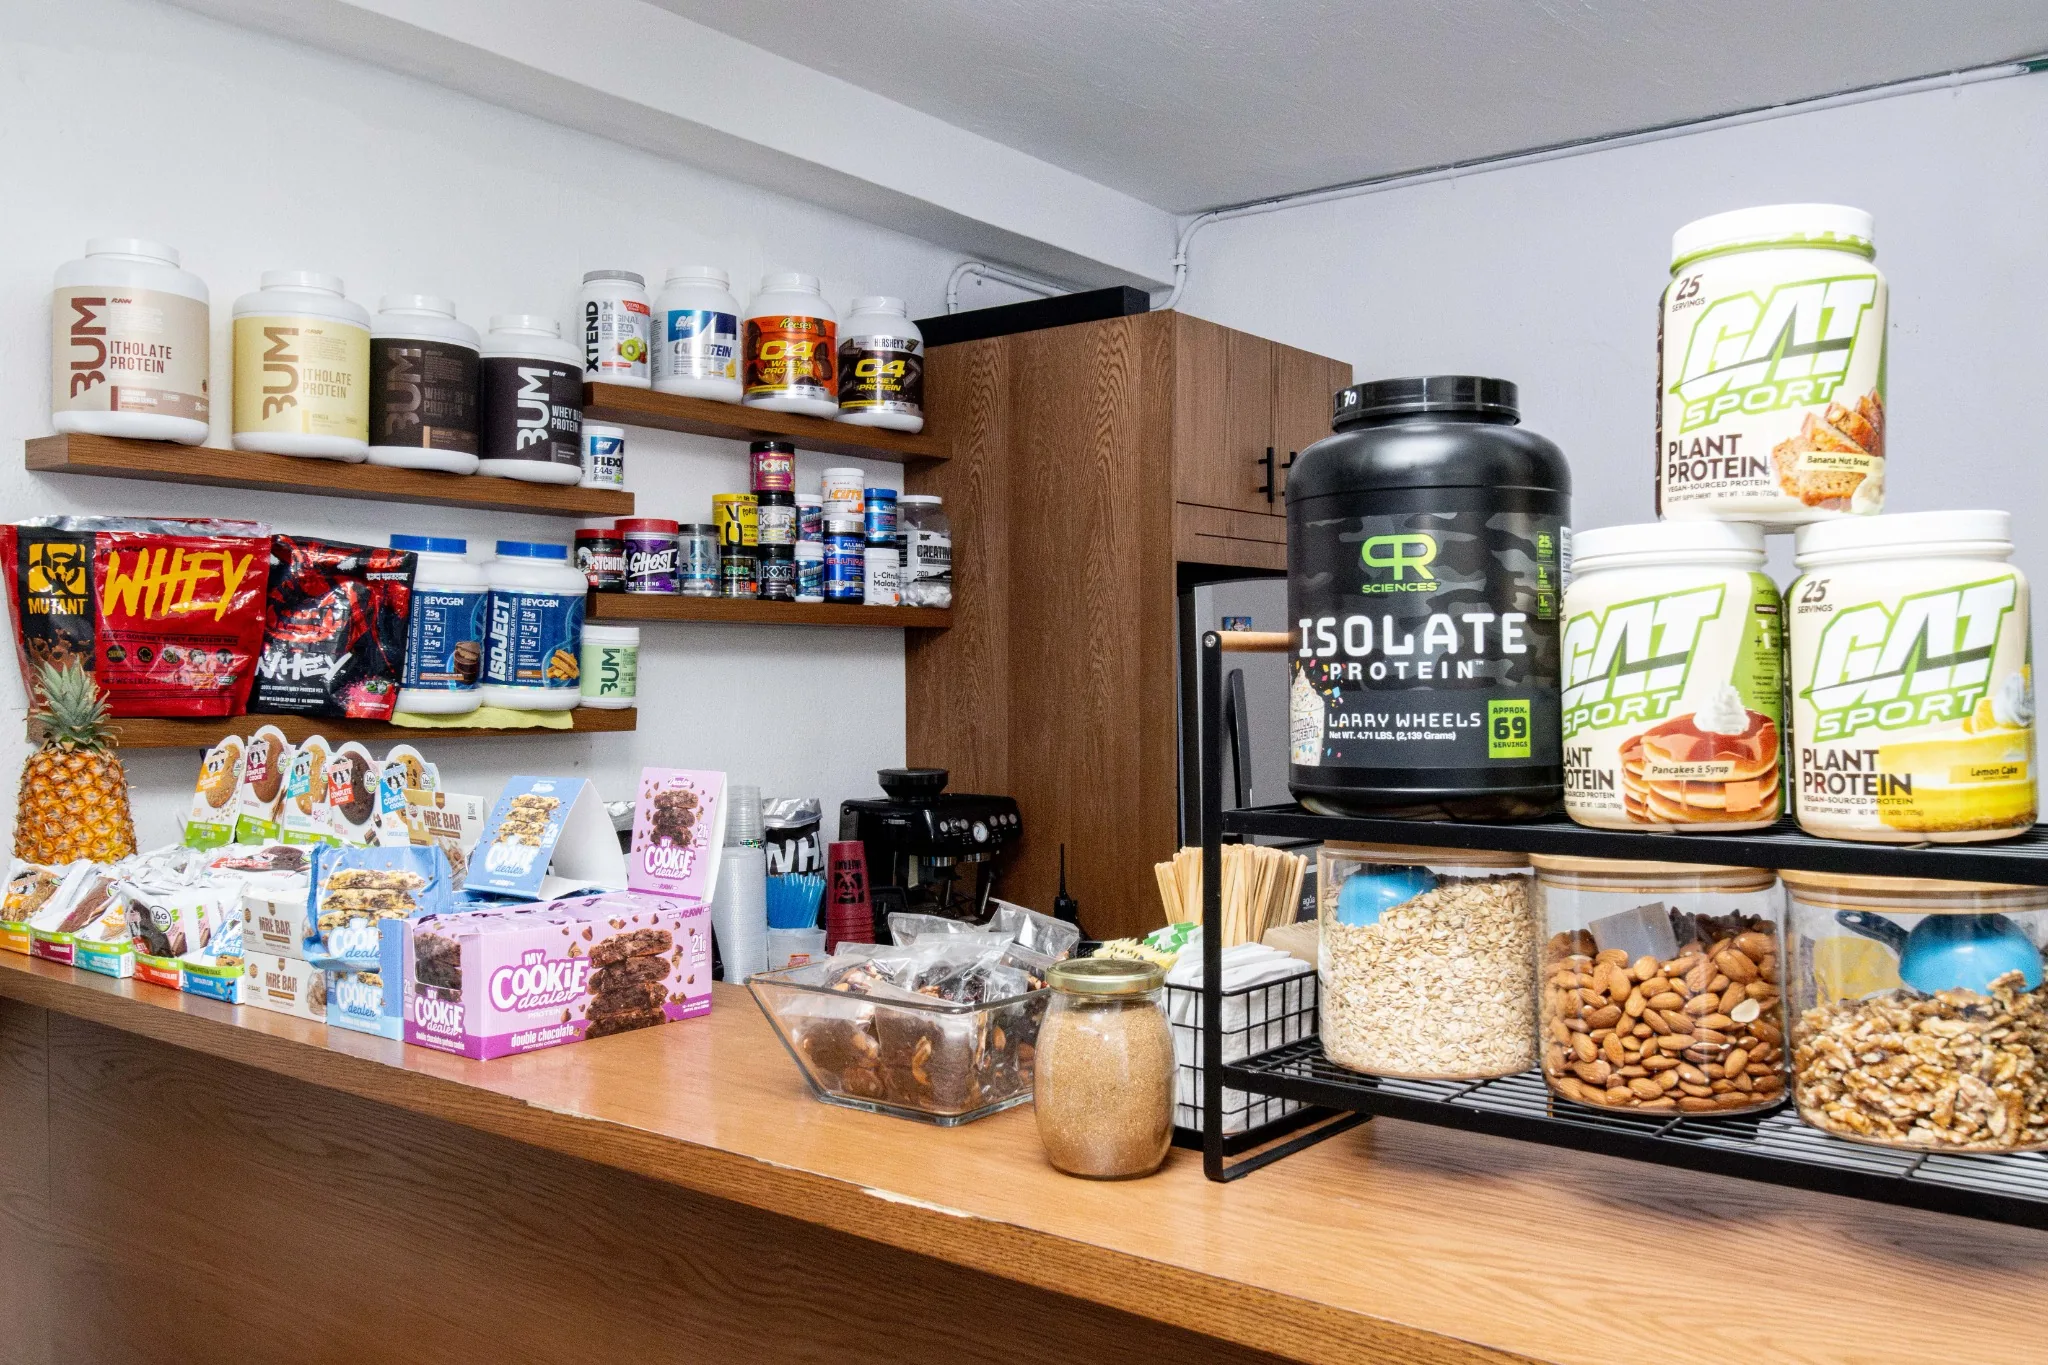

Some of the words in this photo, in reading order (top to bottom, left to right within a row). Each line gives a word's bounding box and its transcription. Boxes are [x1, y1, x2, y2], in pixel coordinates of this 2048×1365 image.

[1675, 274, 1704, 301] 25
[1672, 297, 1706, 312] SERVINGS
[585, 301, 599, 373] XTEND
[874, 338, 904, 349] HERSHEY'S
[1669, 274, 1877, 402] GAT
[110, 340, 172, 360] ITHOLATE
[760, 340, 814, 360] C4
[110, 356, 164, 373] PROTEIN
[764, 367, 810, 375] PROTEIN
[855, 358, 905, 378] C4
[302, 368, 352, 386] ITHOLATE
[302, 382, 347, 399] PROTEIN
[1684, 376, 1842, 429] SPORT
[552, 405, 572, 418] WHEY
[1669, 434, 1742, 462] PLANT
[1807, 456, 1836, 464] Banana
[1839, 456, 1851, 465] Nut
[1854, 458, 1869, 467] Bread
[1669, 456, 1768, 484] PROTEIN
[629, 549, 678, 577] GHOST
[102, 548, 254, 622] WHEY
[1362, 582, 1438, 593] SCIENCES
[1801, 579, 1831, 603] 25
[28, 598, 86, 614] MUTANT
[430, 597, 464, 606] EVOGEN
[527, 598, 559, 607] EVOGEN
[1797, 604, 1833, 614] SERVINGS
[425, 610, 440, 618] 25g
[522, 611, 536, 619] 25g
[424, 624, 442, 633] 11.7g
[521, 625, 538, 633] 11.7g
[1299, 612, 1527, 657] ISOLATE
[487, 596, 510, 682] ISOJECT
[1800, 574, 2015, 710] GAT
[1492, 706, 1527, 715] APPROX.
[1817, 687, 1983, 737] SPORT
[1328, 714, 1389, 728] LARRY
[1396, 713, 1481, 727] WHEELS
[1493, 717, 1527, 739] 69
[1329, 731, 1341, 739] Net
[1342, 731, 1357, 739] WT.
[1357, 731, 1374, 739] 4.71
[1375, 731, 1395, 739] LBS.
[1396, 731, 1422, 741] (2,139
[1424, 731, 1456, 741] Grams)
[1492, 740, 1528, 749] SERVINGS
[1802, 748, 1880, 771] PLANT
[1652, 765, 1694, 774] Pancakes
[1705, 764, 1729, 774] Syrup
[1971, 767, 1999, 777] Lemon
[2001, 766, 2018, 775] Cake
[1803, 771, 1912, 796] PROTEIN
[1804, 795, 1867, 805] VEGAN-SOURCED
[681, 906, 703, 919] RAW
[691, 934, 707, 953] 21g
[524, 952, 544, 966] MY
[427, 989, 438, 999] MY
[518, 989, 577, 1009] dealer
[347, 1002, 377, 1018] dealer
[427, 1020, 459, 1036] dealer
[511, 1031, 537, 1047] double
[538, 1023, 575, 1042] chocolate
